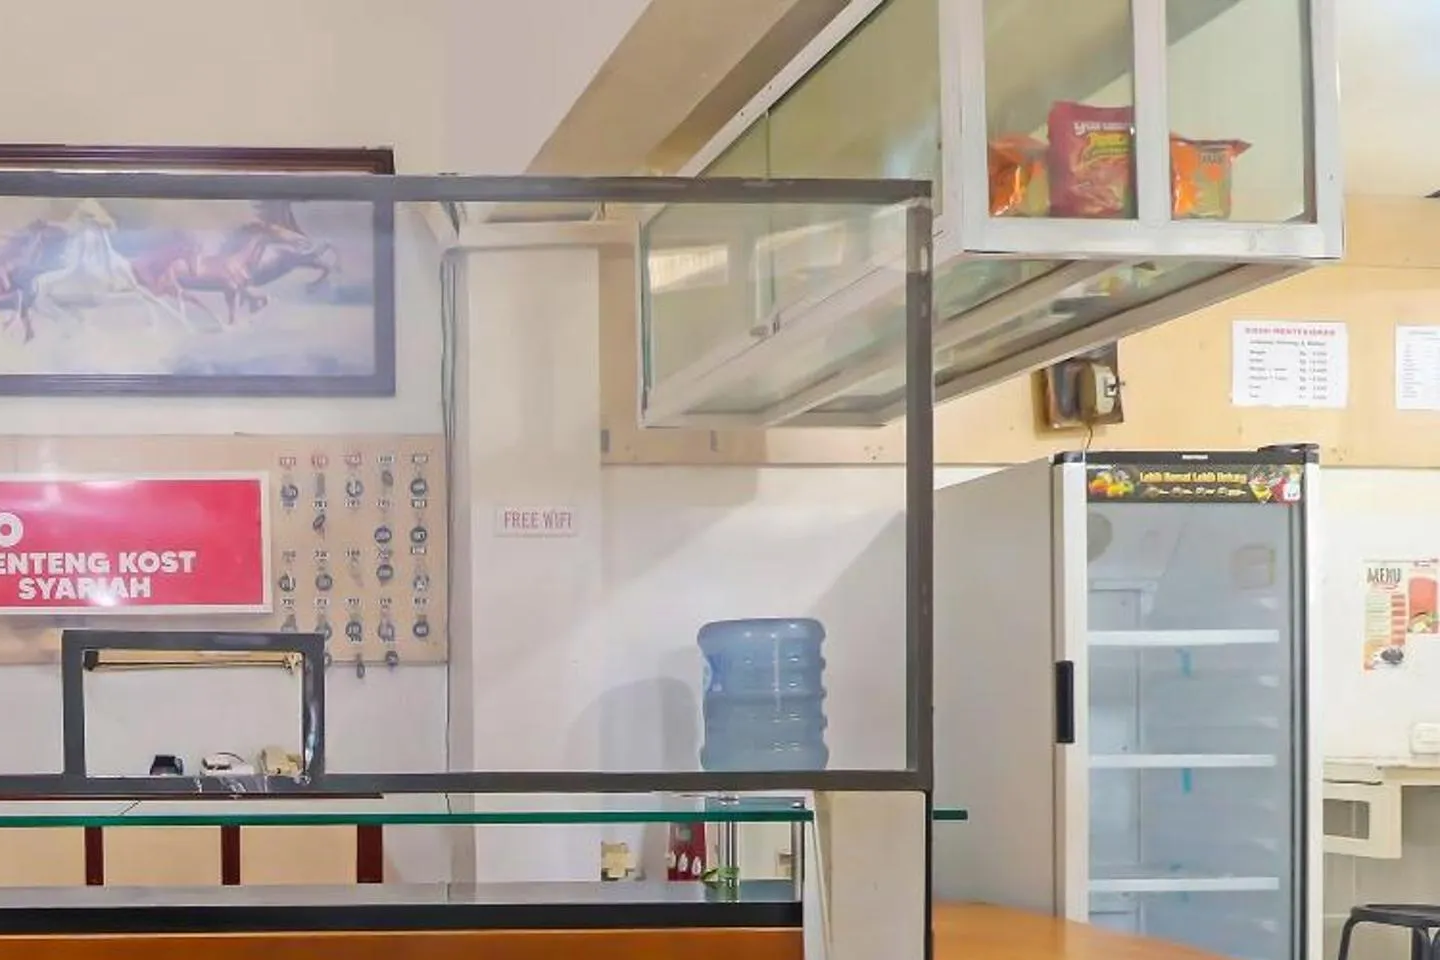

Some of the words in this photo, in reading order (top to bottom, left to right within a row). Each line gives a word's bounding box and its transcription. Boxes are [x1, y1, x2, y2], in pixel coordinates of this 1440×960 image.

[504, 511, 540, 529] FREE
[118, 550, 197, 574] KOST
[1367, 567, 1402, 583] MENU
[18, 576, 152, 601] SYARIAH
